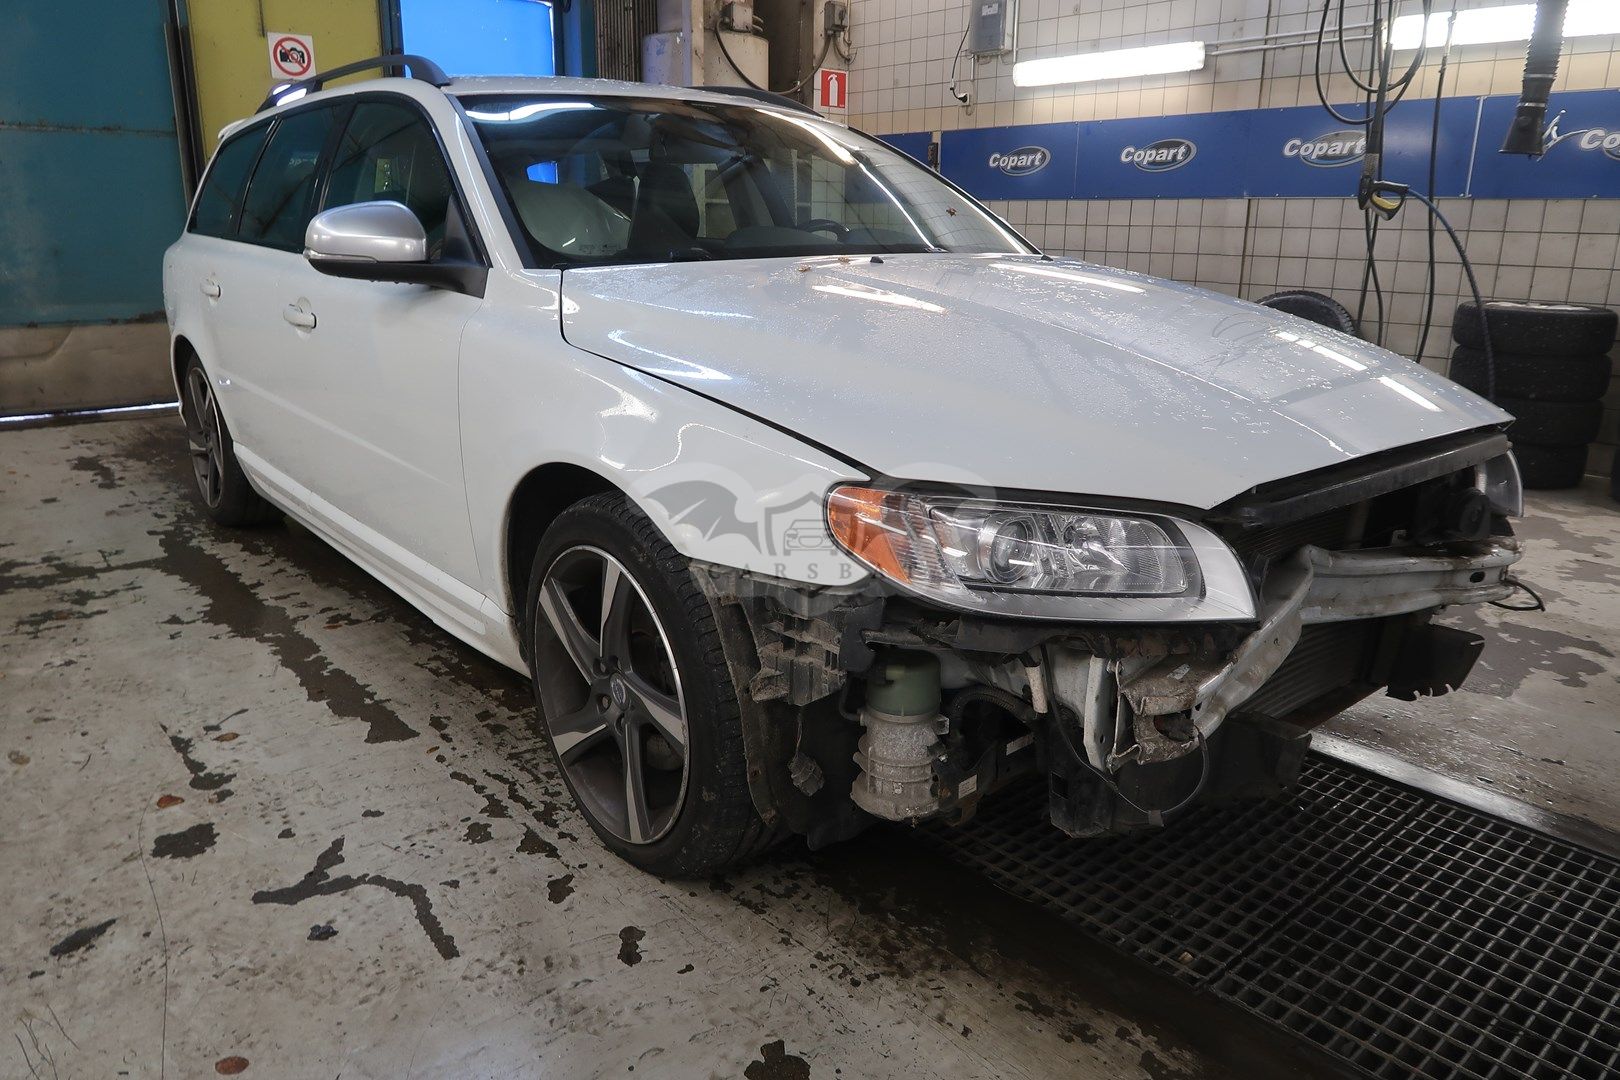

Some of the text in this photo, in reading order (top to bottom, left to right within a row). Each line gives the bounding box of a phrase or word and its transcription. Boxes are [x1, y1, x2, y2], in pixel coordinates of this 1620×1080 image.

[1283, 138, 1367, 160] Copart
[1580, 129, 1620, 152] Co
[989, 149, 1044, 169] Copart
[1121, 142, 1187, 164] Copart
